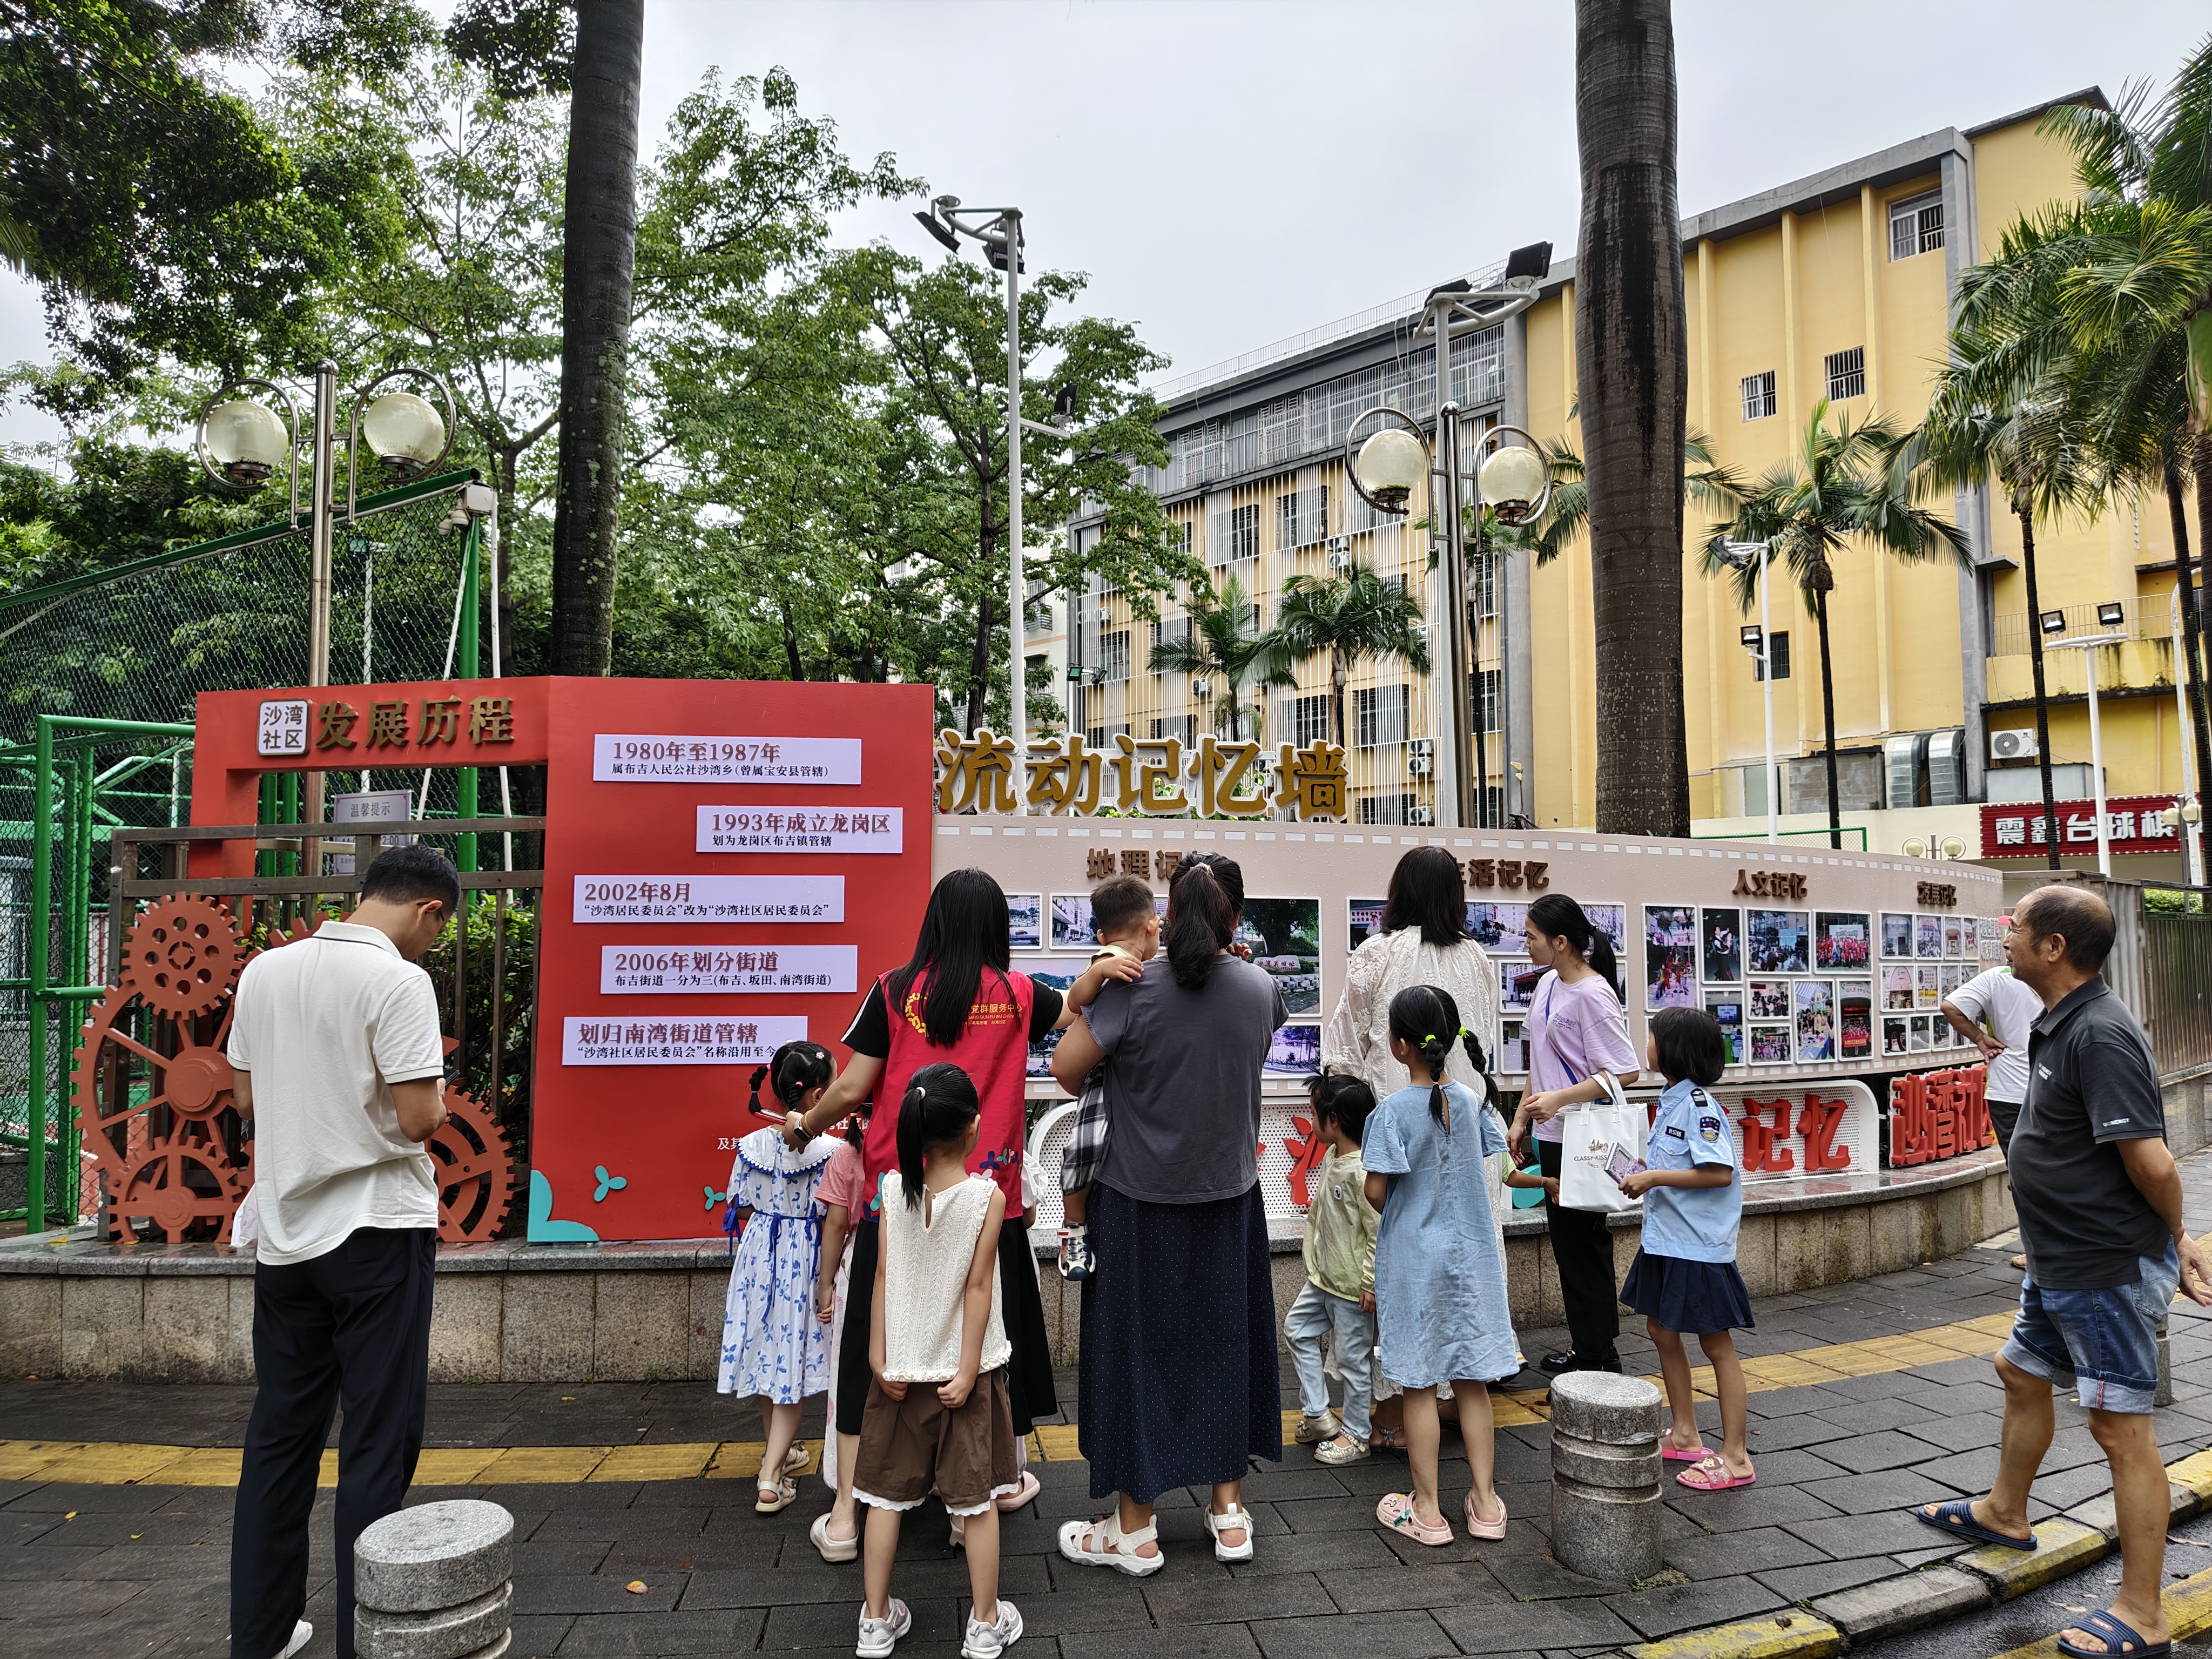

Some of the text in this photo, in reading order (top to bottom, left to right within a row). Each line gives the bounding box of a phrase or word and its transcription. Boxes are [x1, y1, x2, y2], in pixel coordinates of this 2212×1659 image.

[263, 704, 304, 726] 沙湾
[315, 694, 514, 749] 发展历程
[262, 730, 304, 750] 社区
[613, 741, 781, 763] 1980年至1987年
[934, 728, 1350, 822] 流动记忆墙
[350, 801, 391, 817] 温馨提示
[712, 812, 891, 833] 1993年成立龙岗区
[1995, 810, 2203, 845] 震鑫台球棋
[380, 835, 399, 845] 2:00
[712, 834, 832, 847] 划为龙岗区布吉镇管辖
[585, 881, 691, 902] 2002年8月
[1731, 869, 1808, 898] 人文记忆
[1917, 881, 1957, 906] 发展记忆
[615, 951, 779, 973] 2006年划分街道
[577, 1022, 758, 1045] 划归南湾街道管辖
[1737, 1093, 1852, 1172] 记忆
